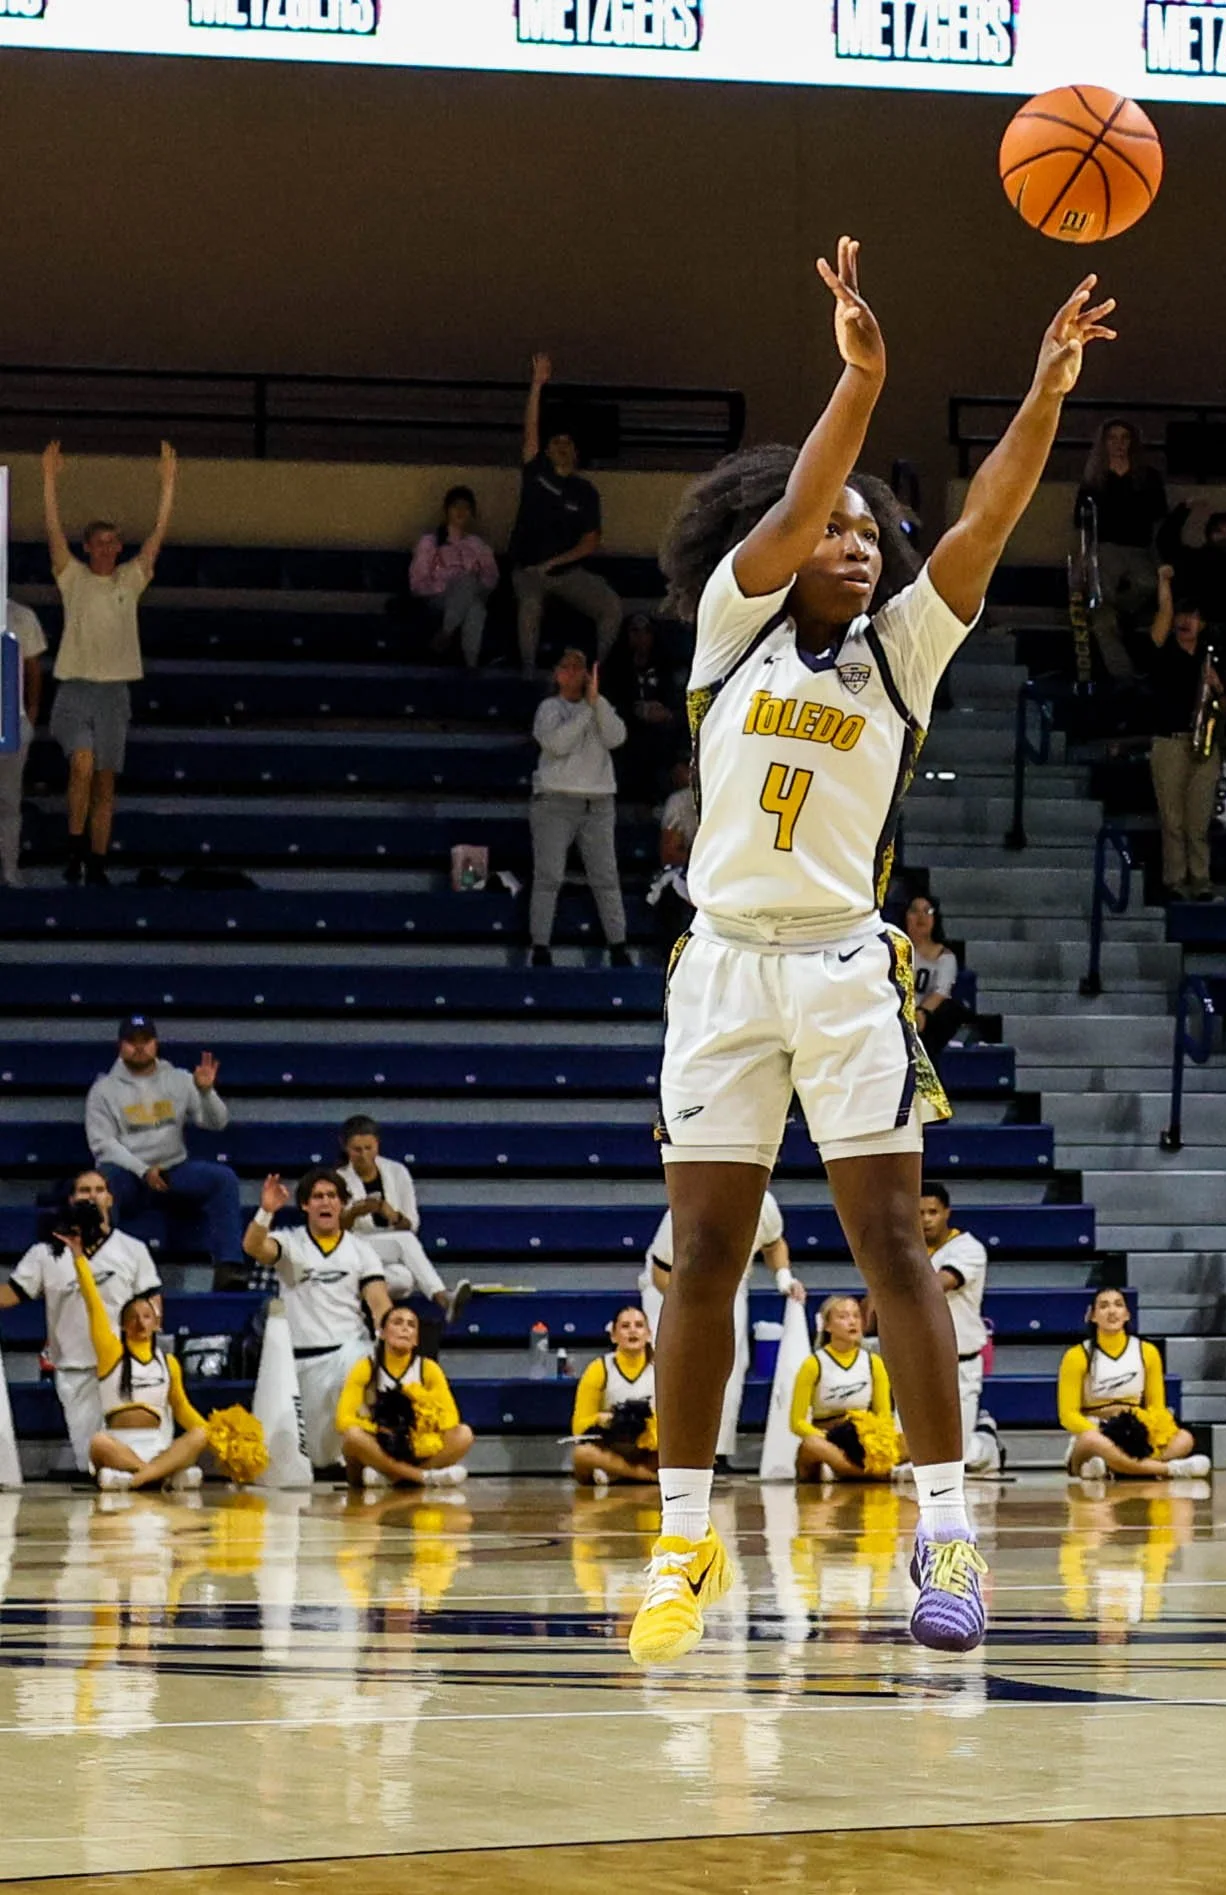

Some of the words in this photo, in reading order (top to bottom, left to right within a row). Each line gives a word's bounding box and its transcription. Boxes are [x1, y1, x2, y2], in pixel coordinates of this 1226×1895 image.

[837, 0, 1012, 64] METZGERS
[743, 689, 866, 752] TOLEDO
[759, 761, 814, 852] 4
